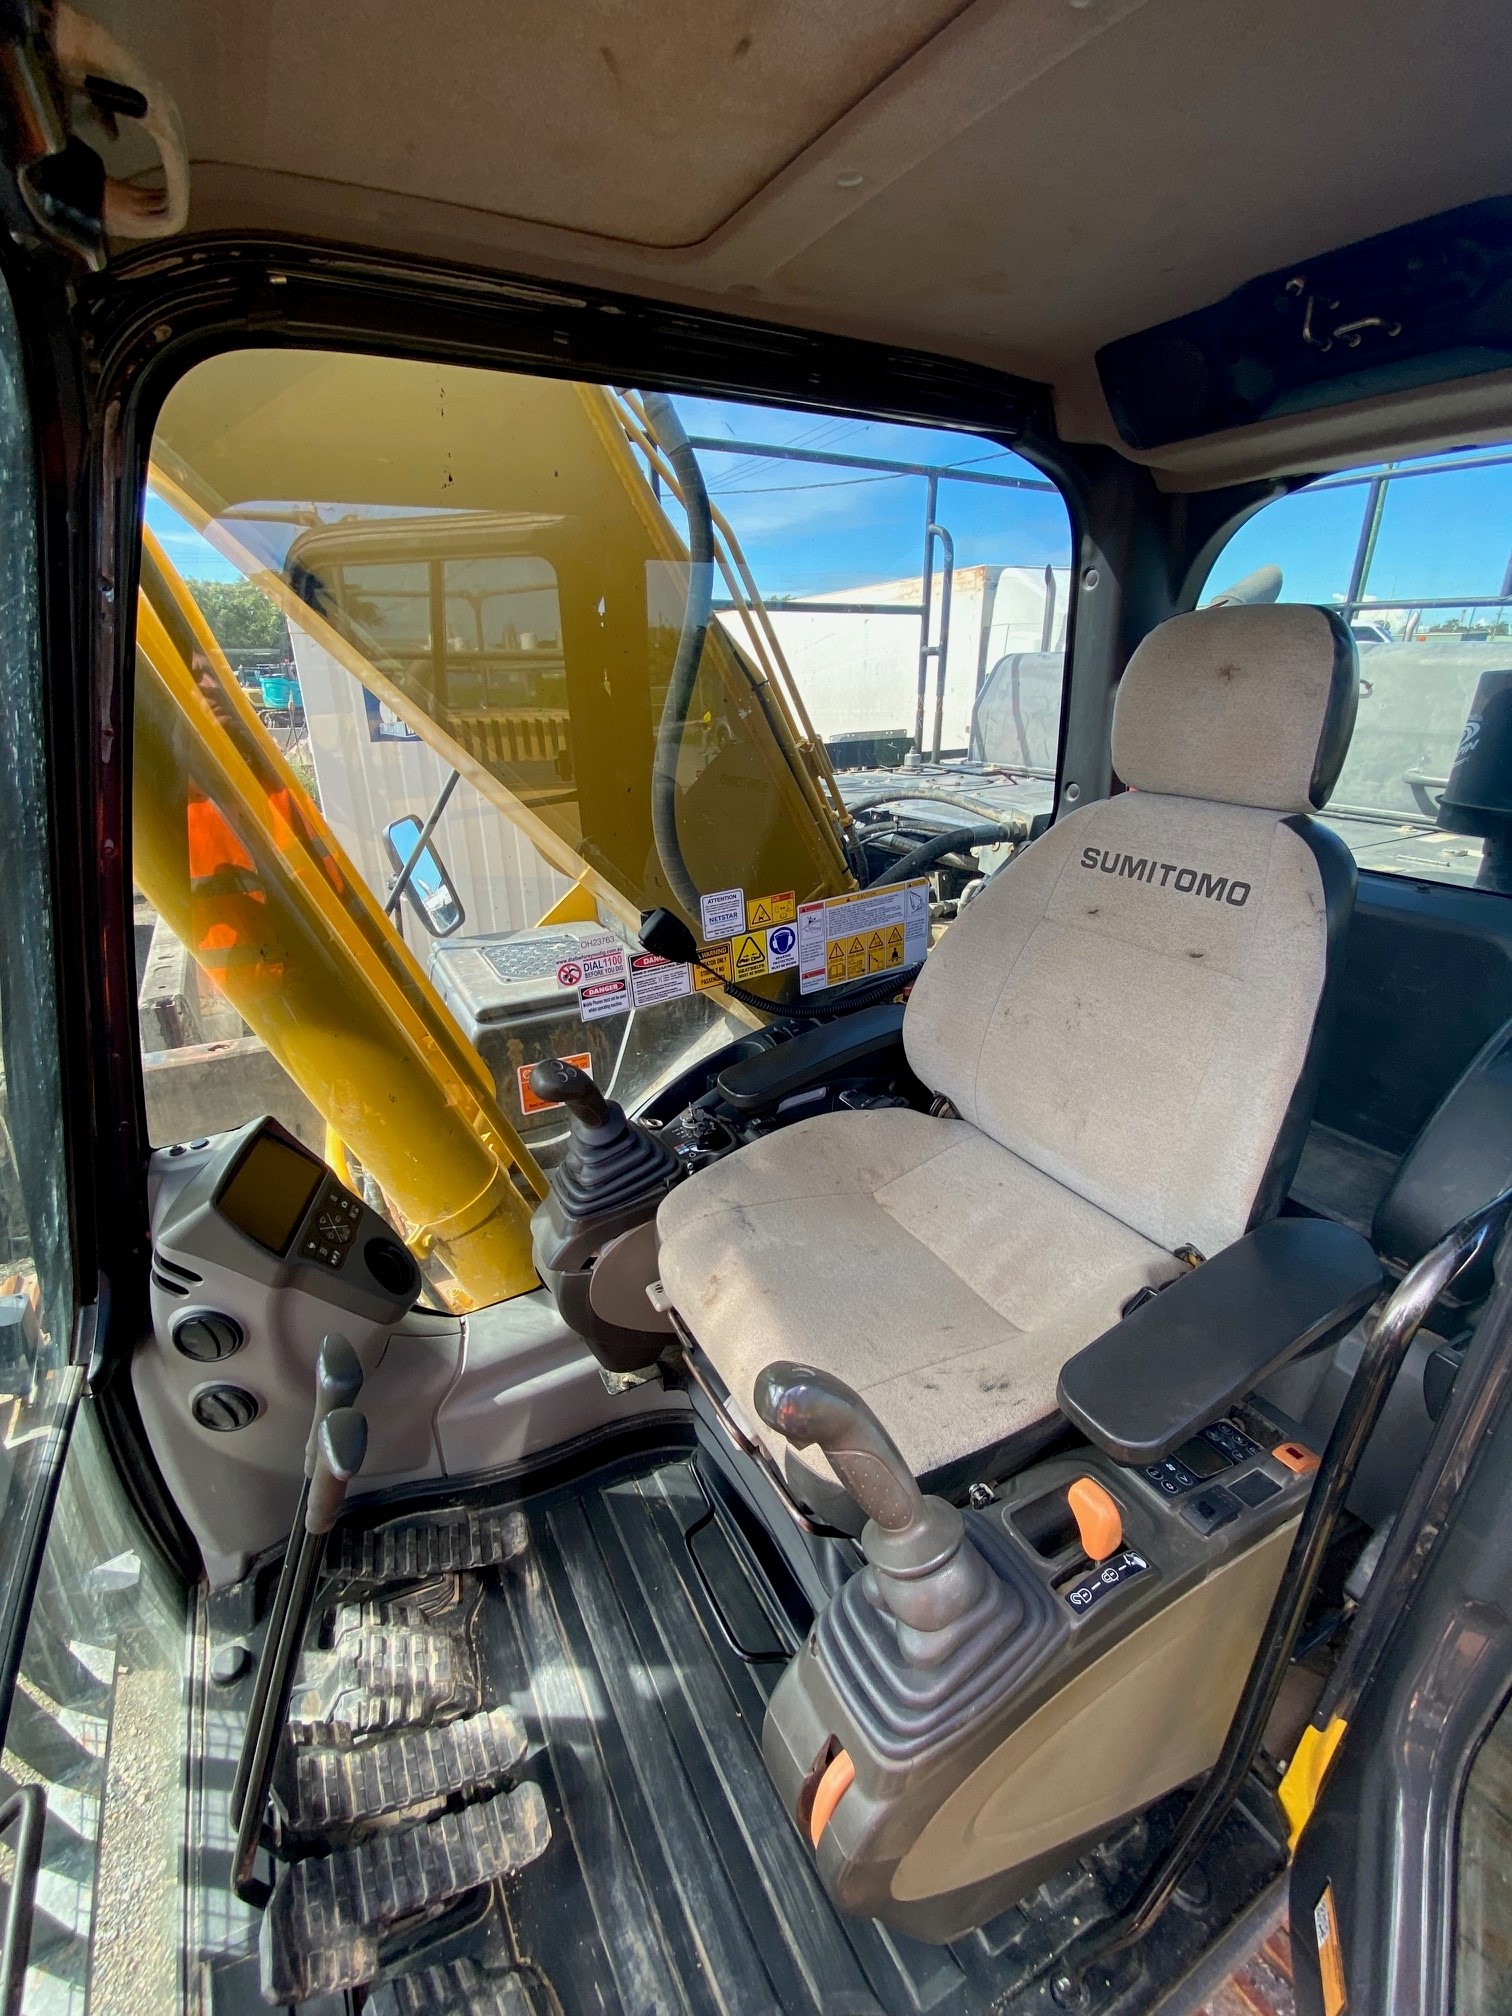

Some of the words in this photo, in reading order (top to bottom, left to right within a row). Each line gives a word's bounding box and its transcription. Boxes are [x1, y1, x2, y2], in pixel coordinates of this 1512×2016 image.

[1080, 847, 1251, 907] SUMITOMO
[707, 893, 737, 904] ATTENTION
[709, 912, 738, 923] NETSTAR
[580, 935, 615, 949] OH23763
[700, 946, 727, 958] WARNING
[643, 955, 667, 965] DAN
[584, 969, 604, 979] BEFORE
[588, 983, 619, 995] DANGER
